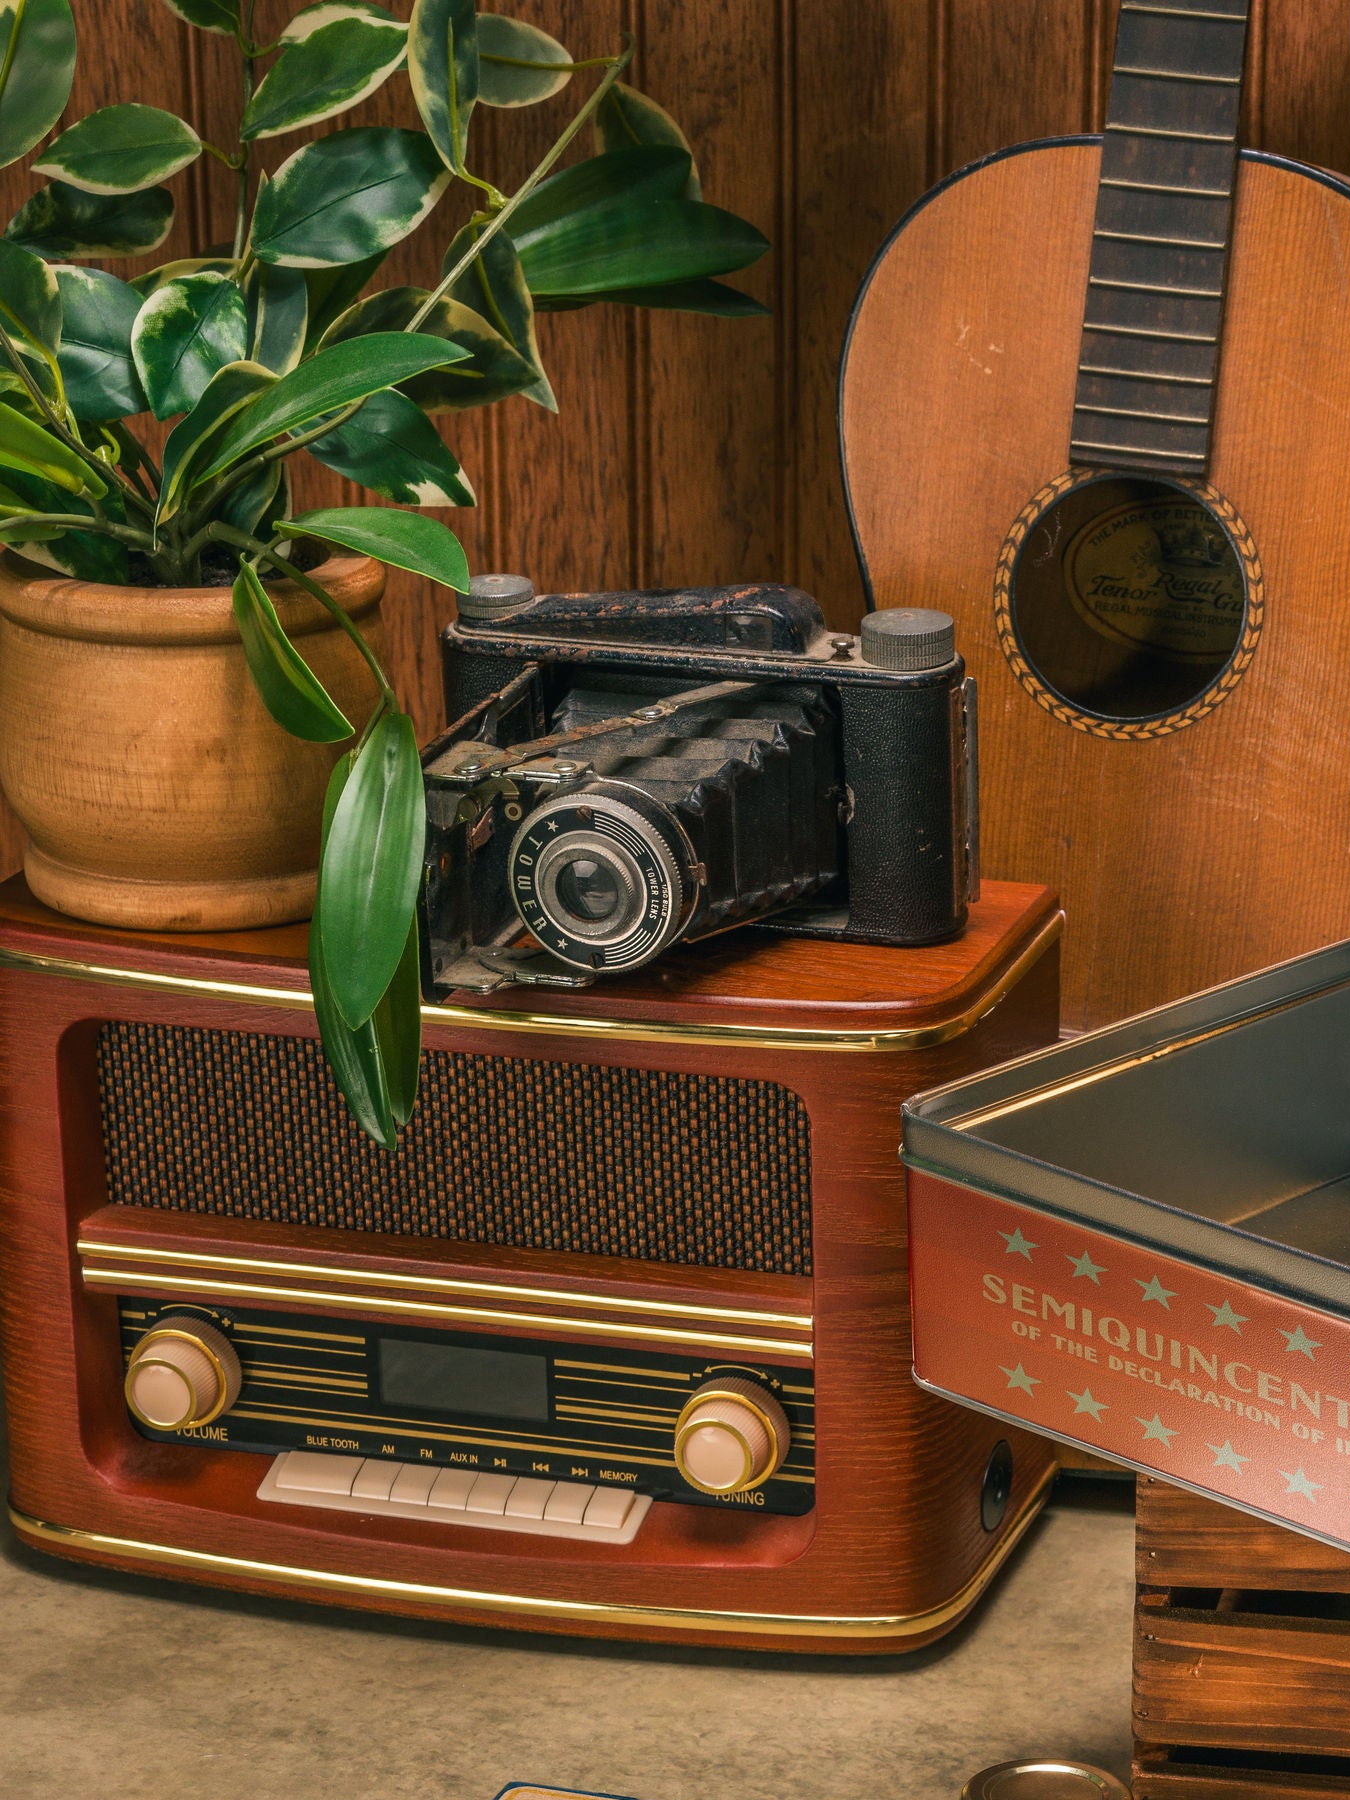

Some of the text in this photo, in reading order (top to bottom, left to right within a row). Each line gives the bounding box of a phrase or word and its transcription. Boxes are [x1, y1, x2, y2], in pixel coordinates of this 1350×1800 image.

[1112, 512, 1146, 532] MARK
[1175, 508, 1218, 524] BETTE
[1152, 567, 1223, 603] Regal
[1087, 575, 1157, 601] Tenor
[1213, 592, 1244, 613] Gu
[1185, 611, 1243, 628] INSTRUME
[516, 836, 548, 932] TOWER
[645, 866, 661, 920] TOWER LENS
[1011, 1320, 1042, 1341] OF
[1051, 1333, 1098, 1364] THE
[1108, 1354, 1281, 1430] DECLARATION
[1291, 1421, 1325, 1444] OF
[175, 1425, 229, 1442] VOLUME
[306, 1435, 359, 1450] BLUE TOOTH
[381, 1444, 395, 1454] AM
[419, 1448, 433, 1459] FM
[450, 1452, 478, 1464] AUX IN
[599, 1470, 638, 1483] MEMORY
